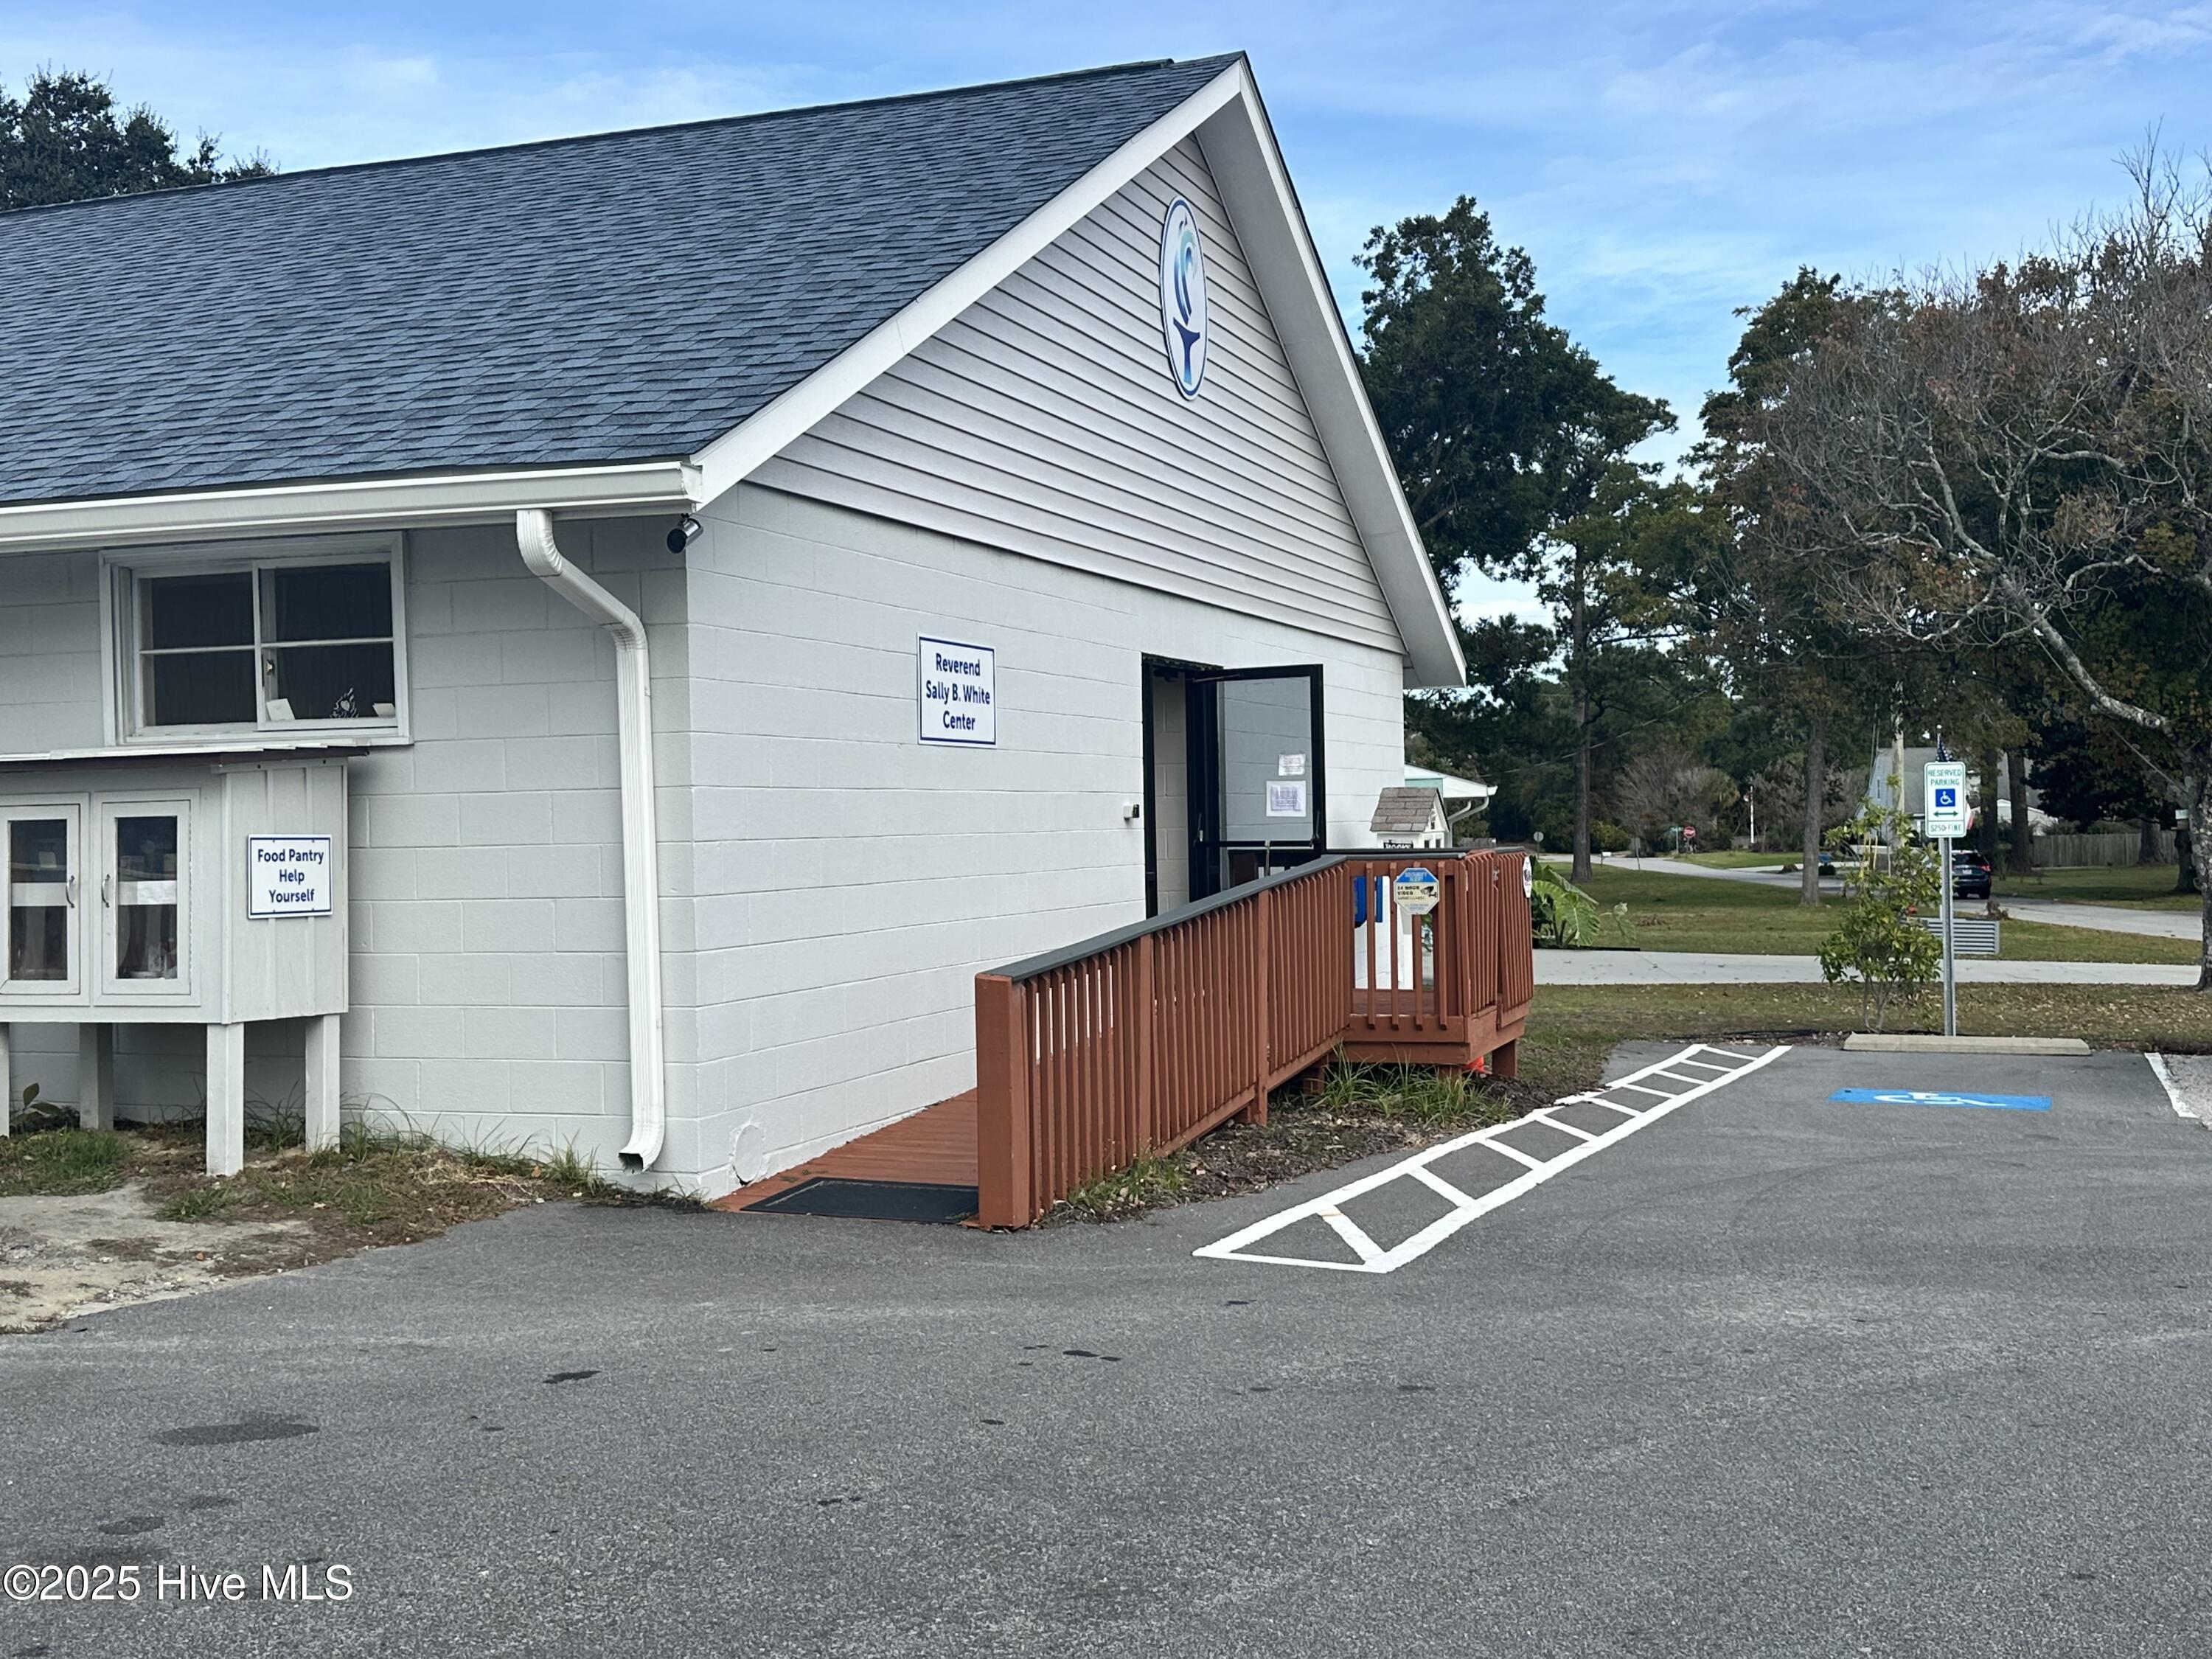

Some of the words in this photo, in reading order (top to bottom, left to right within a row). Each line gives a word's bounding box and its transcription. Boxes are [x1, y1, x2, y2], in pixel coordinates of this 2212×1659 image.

[936, 653, 981, 676] Reverend
[926, 680, 950, 705] Sally
[952, 683, 961, 701] B.
[963, 684, 990, 705] White
[943, 710, 975, 731] Center
[257, 849, 285, 862] Food
[289, 849, 324, 865] Pantry
[279, 869, 305, 886] Help
[268, 888, 315, 903] Yourself
